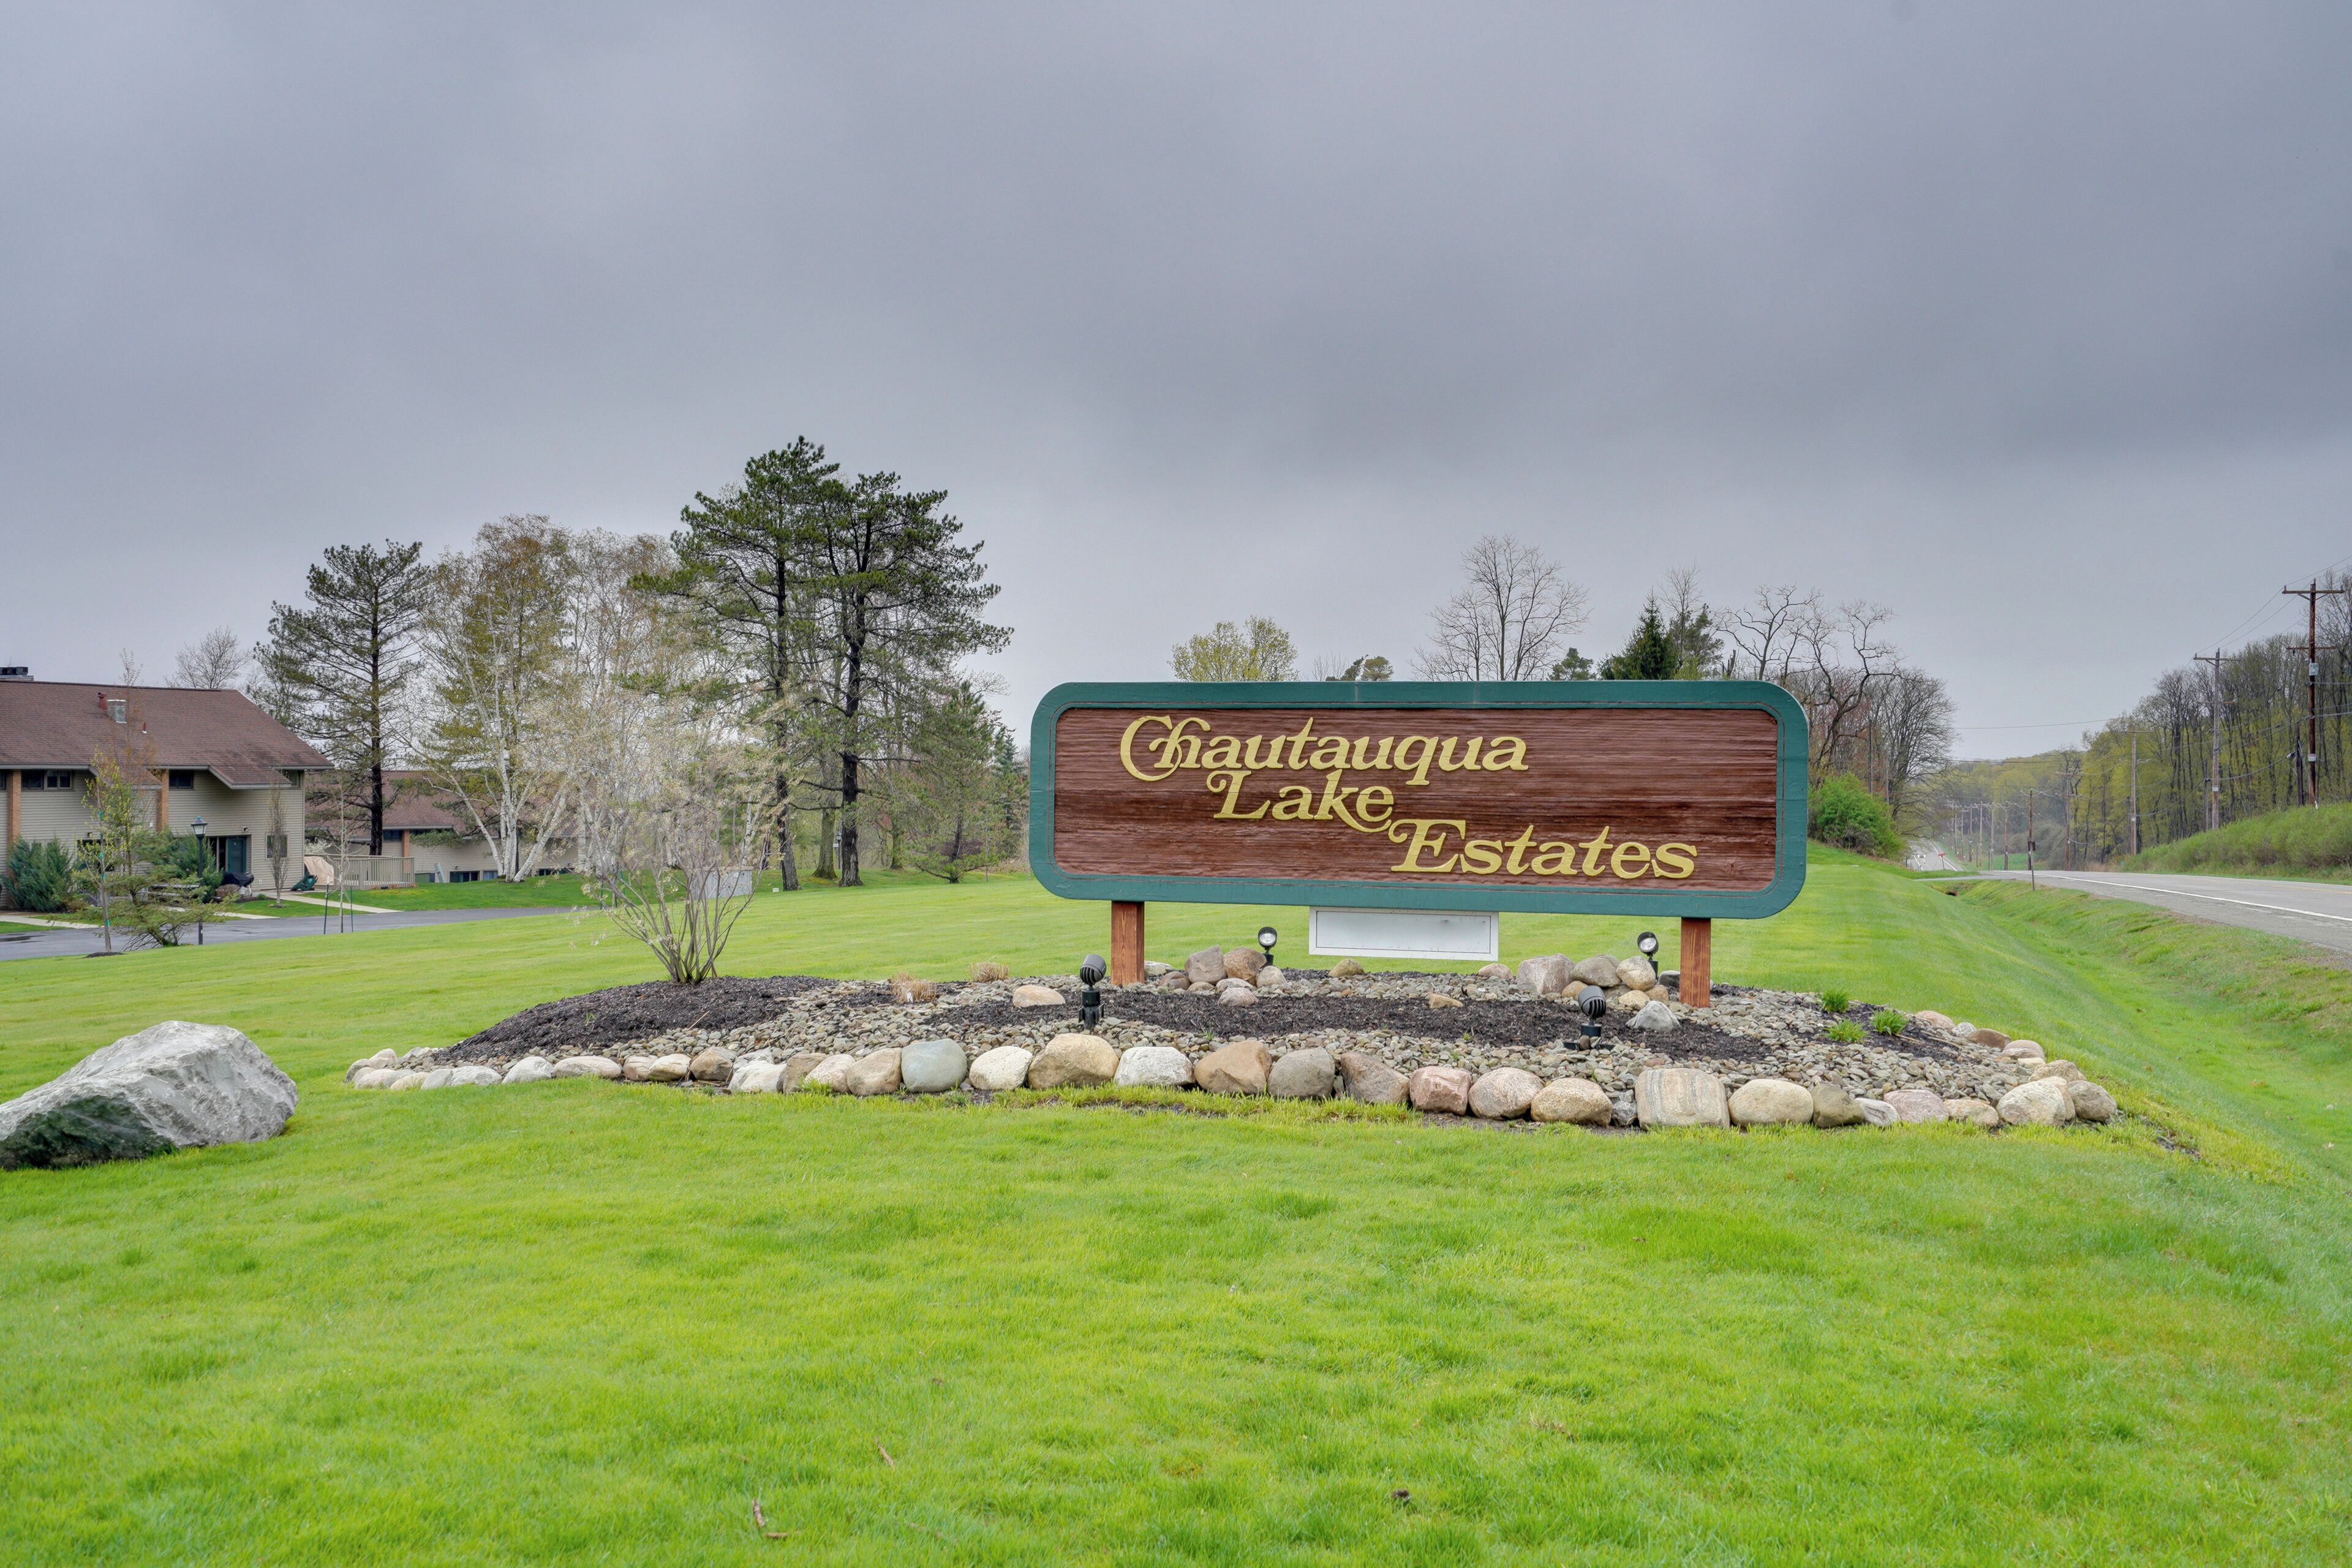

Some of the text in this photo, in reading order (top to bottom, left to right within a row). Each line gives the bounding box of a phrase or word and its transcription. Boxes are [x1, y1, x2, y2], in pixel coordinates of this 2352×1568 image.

[1120, 715, 1529, 785] Chautauqua
[1206, 768, 1395, 834] Lake
[1388, 819, 1698, 879] Estates
